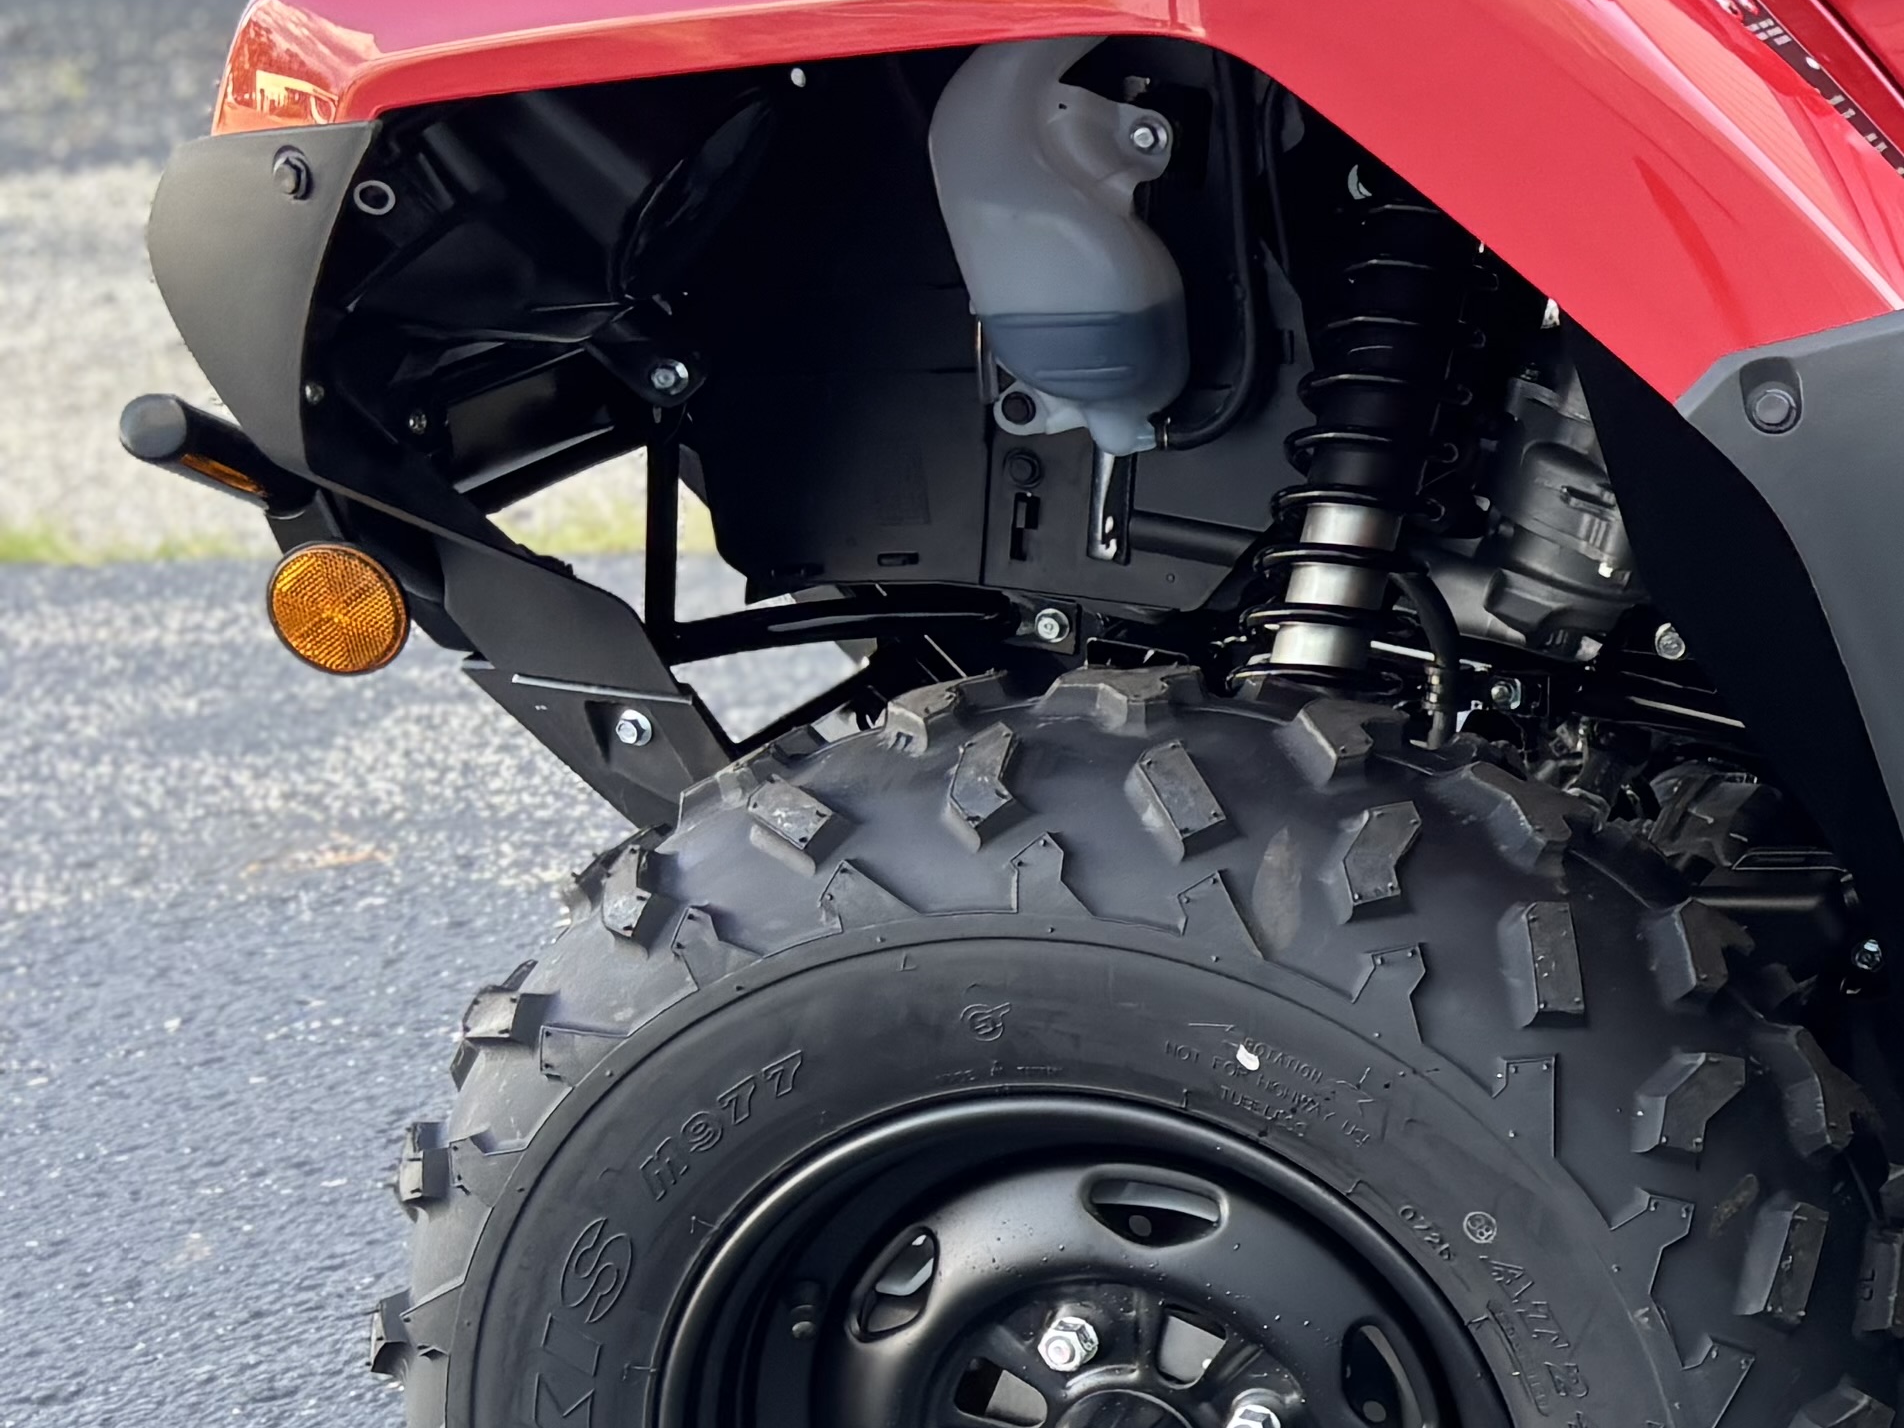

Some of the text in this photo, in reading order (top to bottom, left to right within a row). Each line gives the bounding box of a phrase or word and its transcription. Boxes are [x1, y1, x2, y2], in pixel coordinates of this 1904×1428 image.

[1162, 1039, 1202, 1064] NOT
[1208, 1054, 1251, 1081] FOR
[638, 1048, 804, 1202] M977
